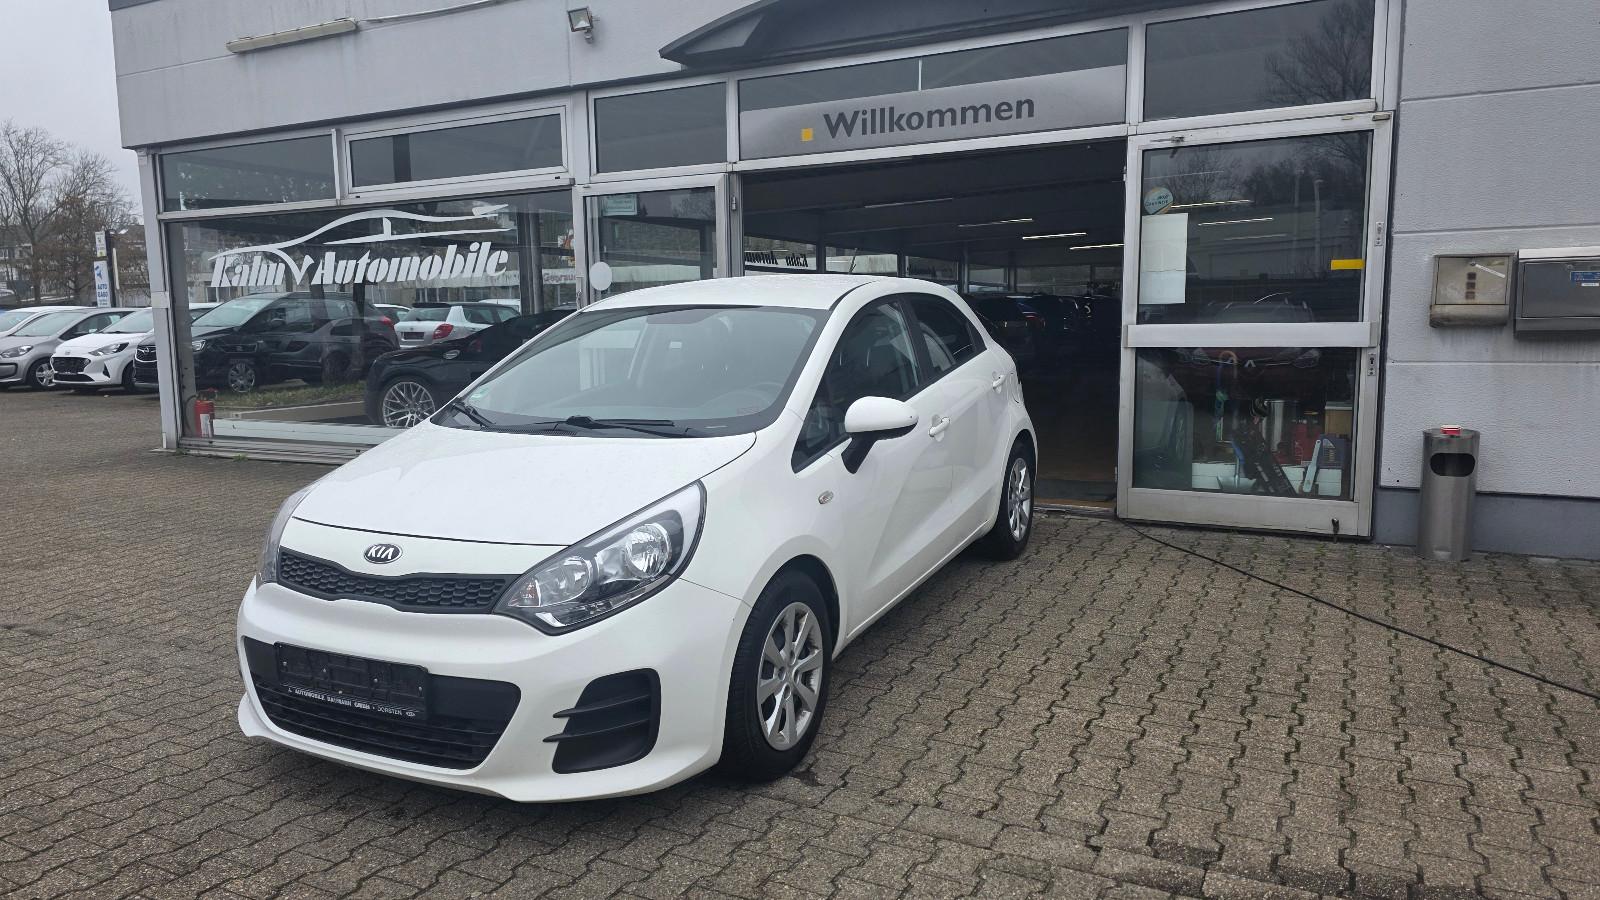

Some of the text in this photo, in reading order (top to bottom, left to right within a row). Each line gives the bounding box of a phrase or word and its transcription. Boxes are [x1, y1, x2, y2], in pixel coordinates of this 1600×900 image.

[823, 98, 1035, 139] Willkommen
[210, 241, 509, 287] Kahn Automobile
[367, 546, 395, 560] KIA
[377, 704, 402, 715] DORSTEN
